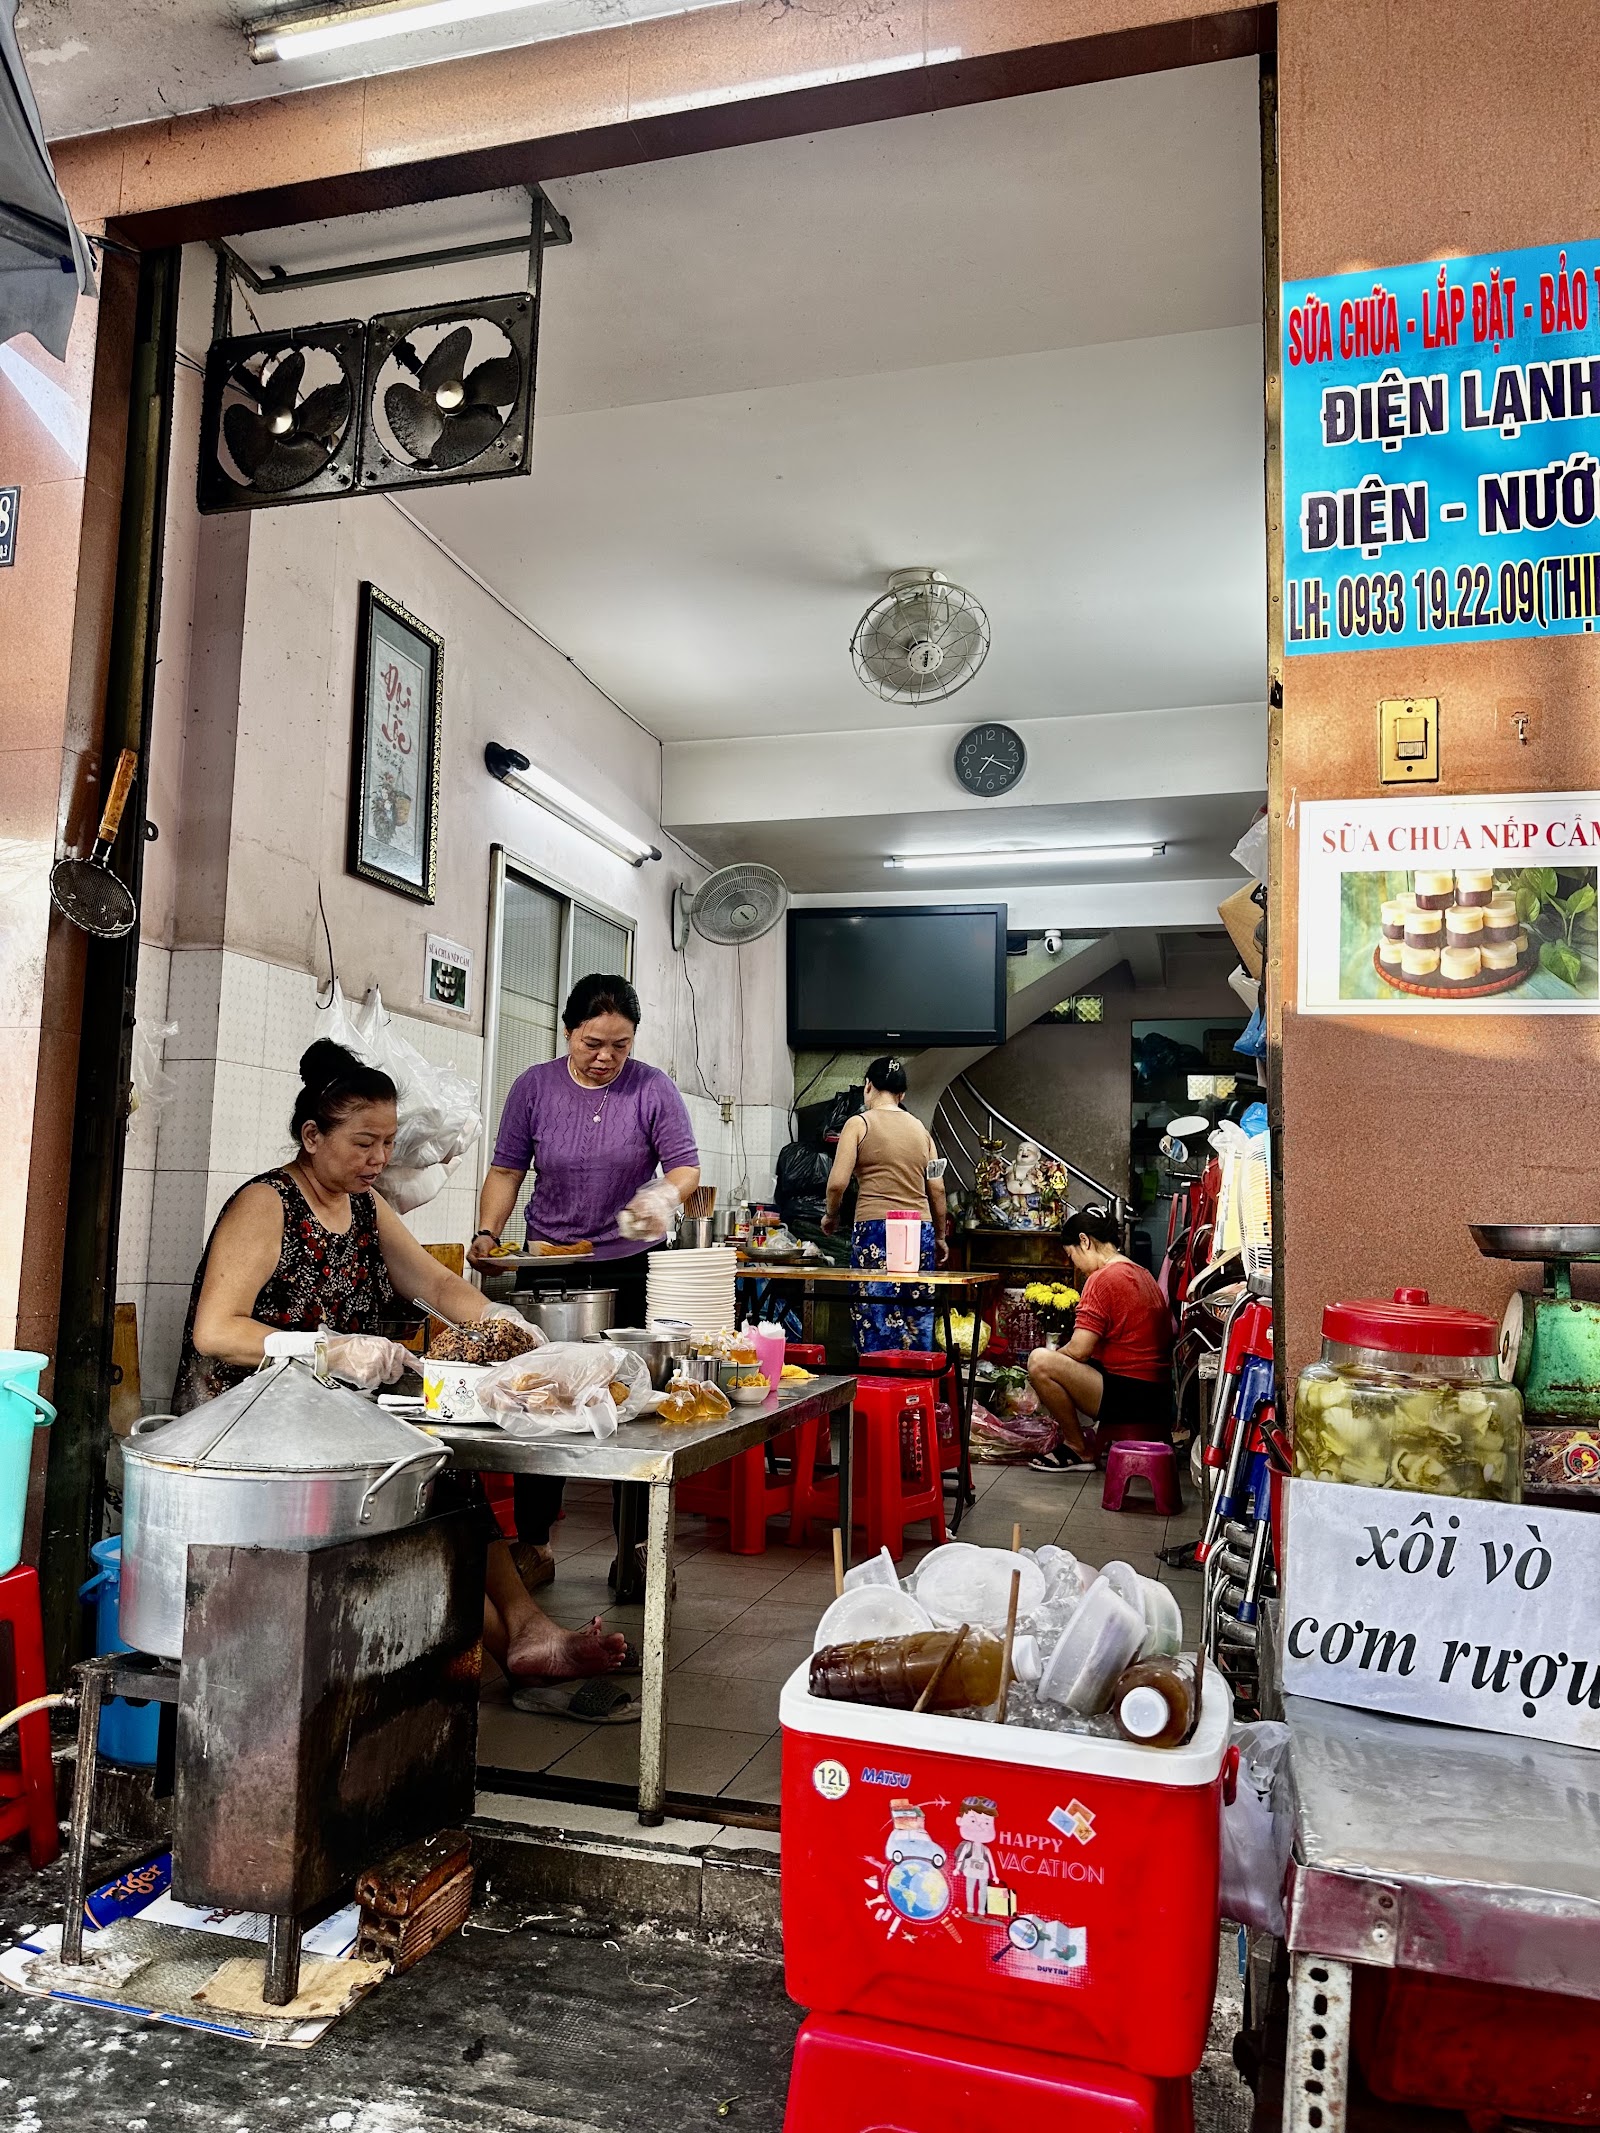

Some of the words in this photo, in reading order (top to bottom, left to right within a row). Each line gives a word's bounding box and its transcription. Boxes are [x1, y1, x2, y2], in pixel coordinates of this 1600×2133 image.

[1288, 293, 1333, 366] SỮA
[1340, 283, 1400, 360] CHỮA
[1422, 263, 1465, 348] LẮP
[1472, 267, 1516, 353] ĐẶT
[1540, 250, 1588, 334] BẢO
[1323, 370, 1446, 451] ĐIỆN
[1463, 359, 1600, 436] LẠNH
[1305, 477, 1428, 557] ĐIỆN
[1483, 456, 1600, 534] NƯỚ
[1289, 578, 1328, 642] LH:
[1337, 569, 1405, 639] 0933
[975, 734, 983, 745] 11
[986, 729, 996, 740] 12
[965, 744, 977, 755] 10
[1008, 740, 1017, 751] 2
[961, 756, 970, 767] 9
[1012, 751, 1020, 763] 3
[964, 768, 972, 779] 8
[1000, 774, 1007, 785] 5
[1009, 765, 1016, 775] 4
[974, 776, 982, 787] 7
[986, 779, 995, 789] 6
[1322, 823, 1379, 853] SỮA
[1387, 825, 1472, 852] CHUA
[1480, 815, 1539, 850] NẾP
[1356, 1511, 1461, 1579] xôi
[1480, 1524, 1553, 1591] vò
[1288, 1616, 1416, 1677] cơm
[1439, 1638, 1600, 1718] rượu
[819, 1766, 846, 1787] 12L
[861, 1766, 912, 1788] MATSU
[999, 1831, 1063, 1853] HAPPY
[997, 1851, 1104, 1885] VACATION
[100, 1864, 164, 1901] Tiger
